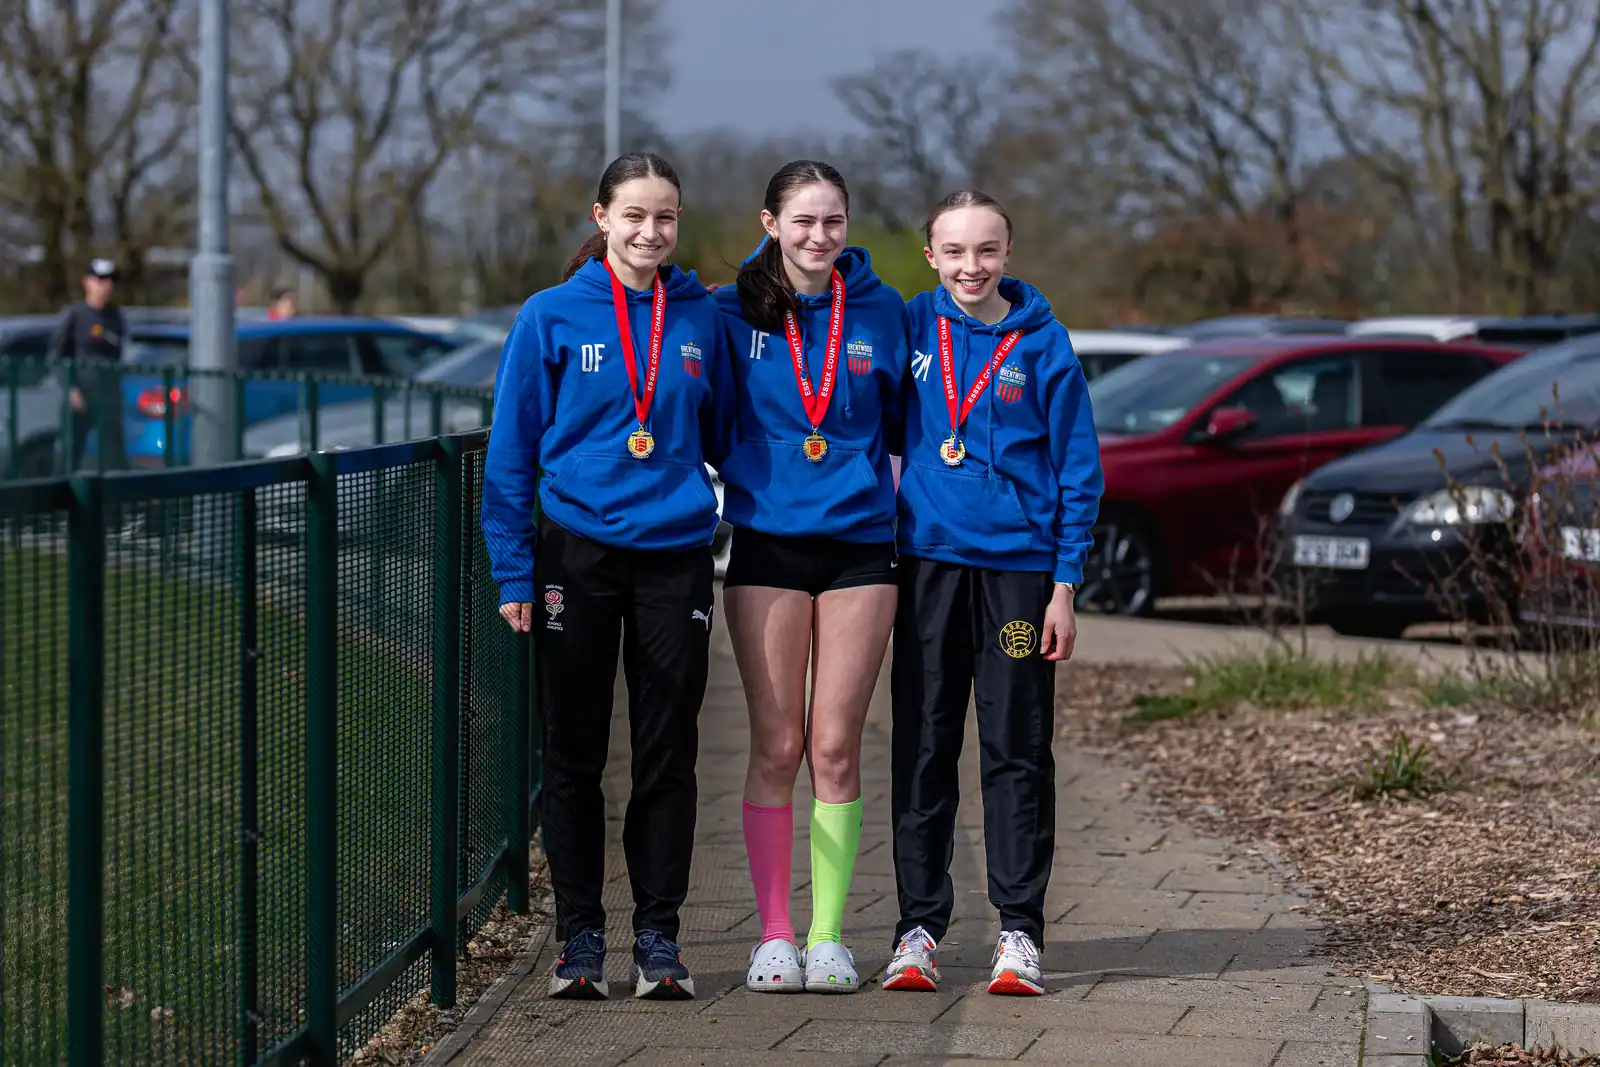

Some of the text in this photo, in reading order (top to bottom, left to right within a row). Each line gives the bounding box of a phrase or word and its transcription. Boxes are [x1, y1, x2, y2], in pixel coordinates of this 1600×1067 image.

[651, 333, 660, 365] COUNTY
[750, 330, 770, 360] IF
[941, 342, 951, 372] COUNTY
[647, 366, 656, 391] ESSEX
[821, 371, 832, 397] ESSEX
[827, 337, 837, 370] COUNTY
[800, 372, 811, 397] ESSE
[944, 373, 955, 400] ESSEX
[967, 379, 985, 403] ESSEX
